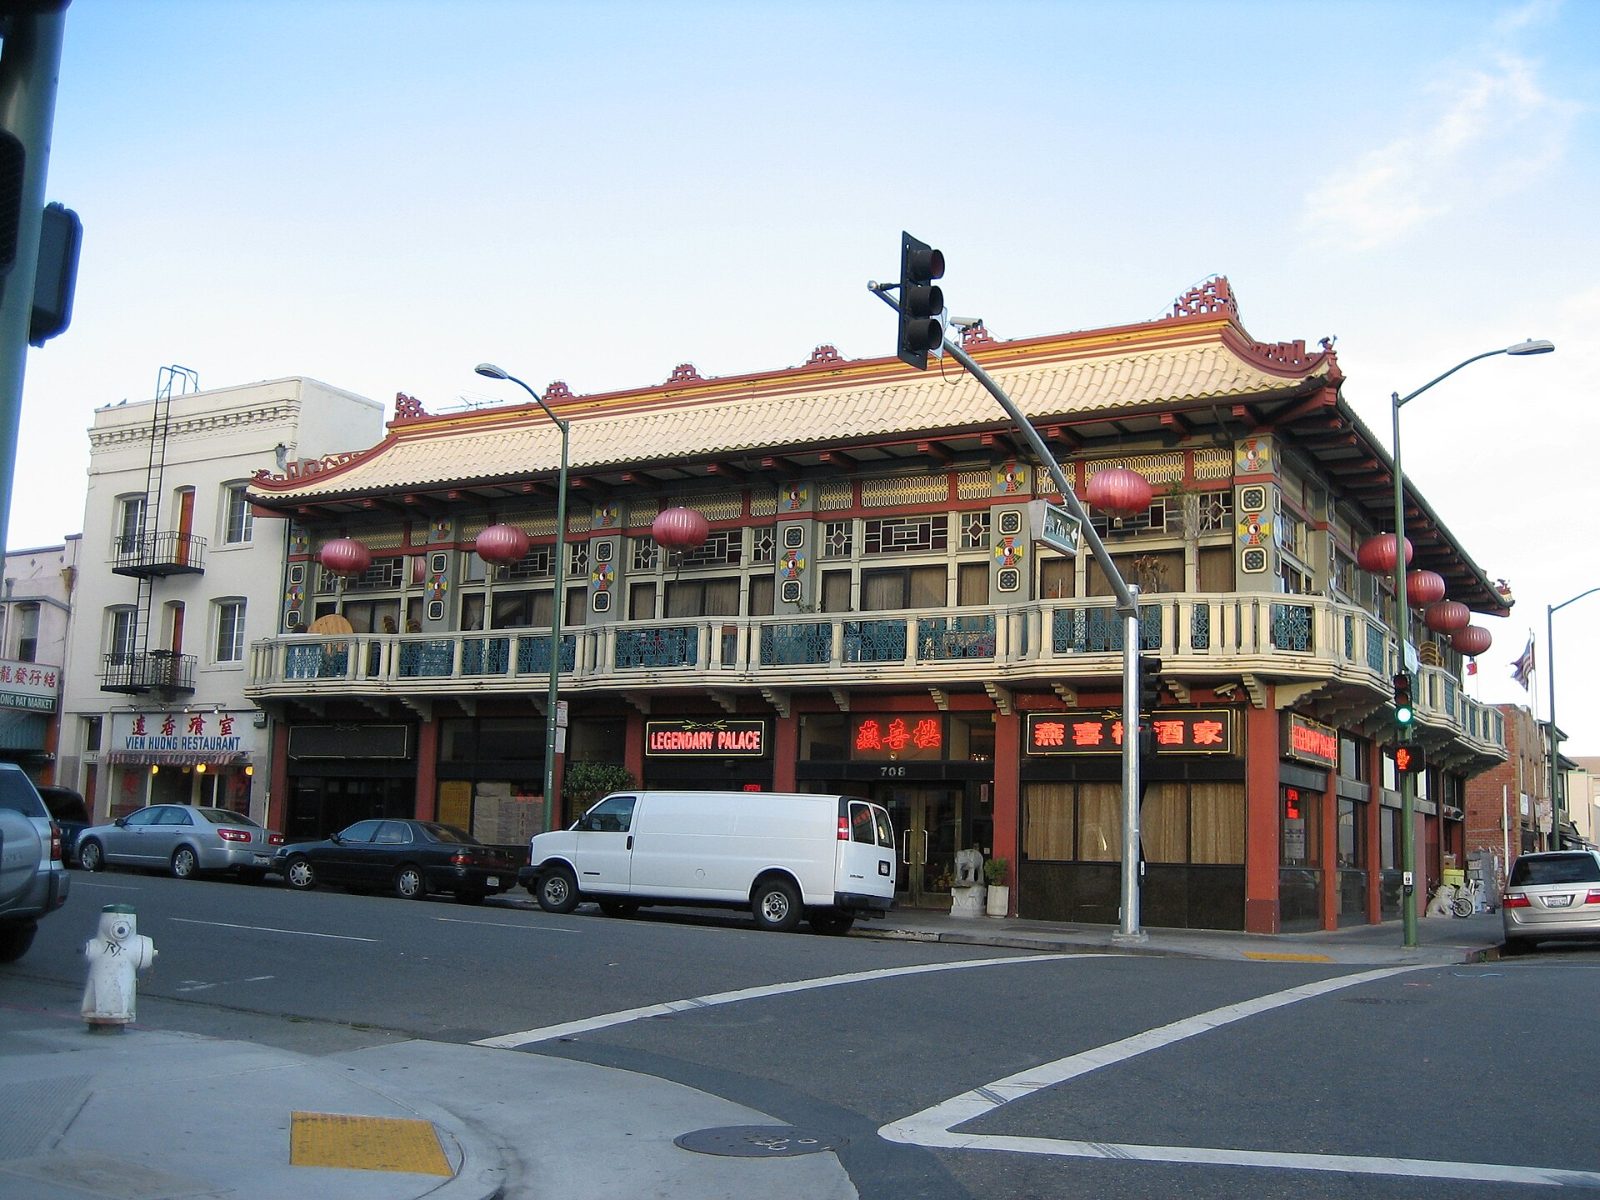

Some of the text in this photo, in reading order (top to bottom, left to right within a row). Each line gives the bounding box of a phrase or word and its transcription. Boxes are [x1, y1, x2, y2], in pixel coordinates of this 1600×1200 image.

[28, 697, 53, 710] MARKET
[125, 736, 241, 751] VIEN HUONG RESTAURANT
[651, 730, 761, 750] LEGENDARY PALACE
[880, 766, 906, 777] 708
